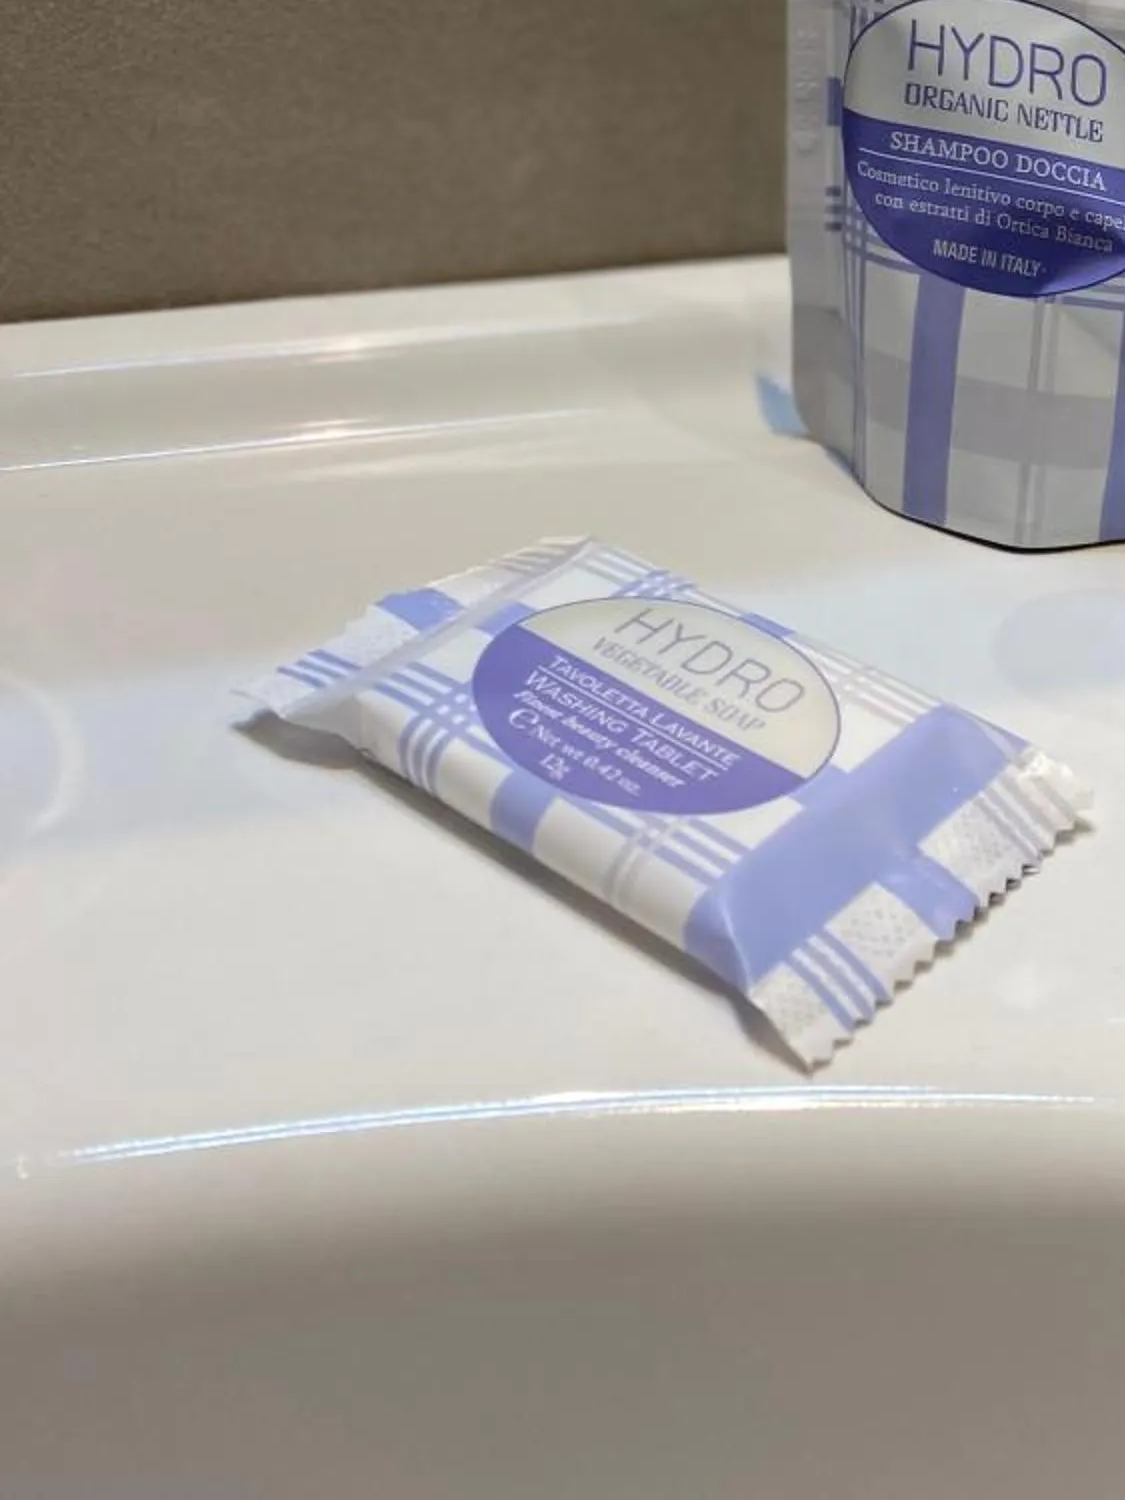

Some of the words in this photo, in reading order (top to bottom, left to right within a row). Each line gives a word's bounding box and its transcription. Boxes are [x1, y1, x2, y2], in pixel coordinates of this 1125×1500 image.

[907, 19, 1107, 107] HYDRO
[904, 82, 1009, 123] ORGANIC
[1017, 103, 1104, 143] NETTLE
[857, 160, 940, 192] Cosmetico
[944, 178, 1011, 205] lenitivo
[1015, 197, 1064, 222] corpo
[1069, 206, 1080, 218] e
[889, 131, 1008, 168] SHAMPOO
[1015, 154, 1107, 191] DOCCIA
[875, 193, 903, 209] con
[975, 208, 991, 226] di
[997, 213, 1049, 239] Ortica
[1056, 226, 1113, 252] Bianca
[933, 239, 977, 265] MADE
[980, 249, 996, 267] IN
[1000, 254, 1041, 278] ITALY
[592, 636, 707, 706] VEGETABLE
[703, 697, 766, 733] SOAP
[614, 608, 806, 713] HYDRO
[526, 670, 629, 733] WASHING
[630, 727, 720, 781] TABLET
[551, 655, 649, 718] TAVOLETTA
[651, 712, 742, 766] LAVANTE
